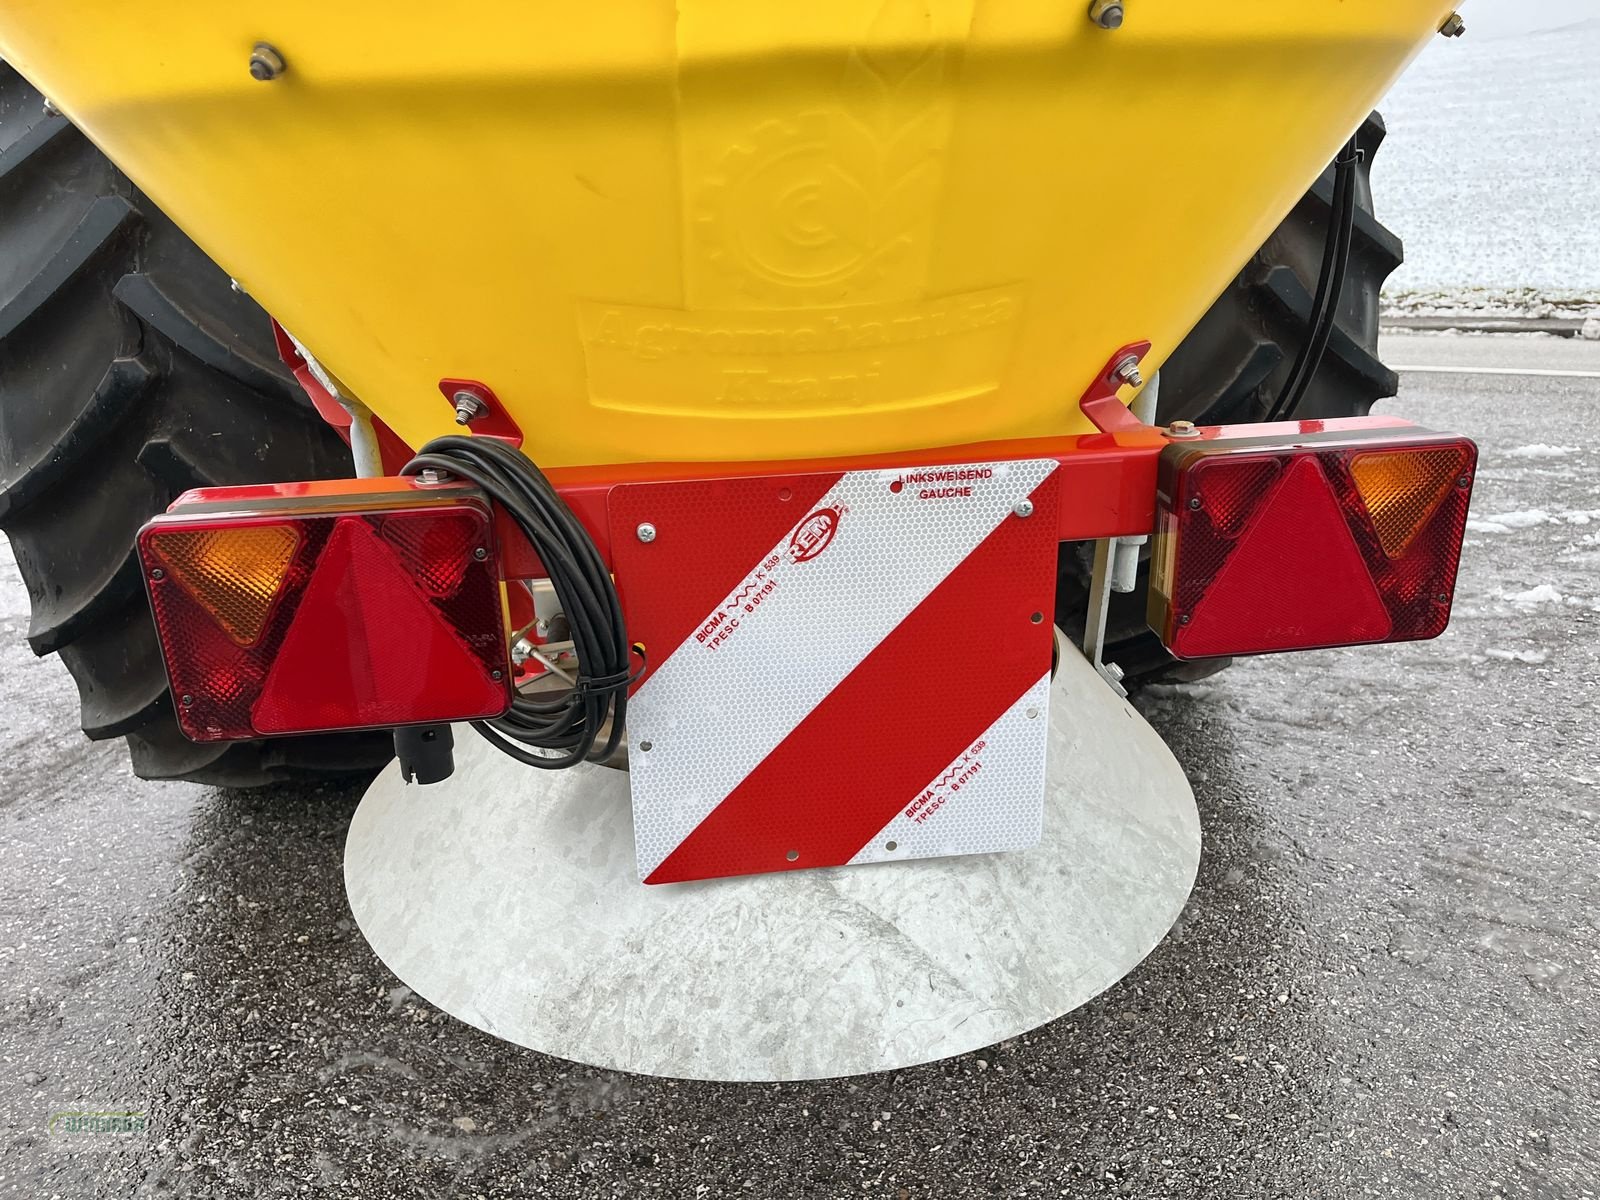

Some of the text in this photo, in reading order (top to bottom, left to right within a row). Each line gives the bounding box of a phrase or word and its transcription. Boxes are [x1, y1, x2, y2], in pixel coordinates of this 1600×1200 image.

[919, 487, 972, 499] GAUCHE
[696, 554, 780, 643] BICMA K 539
[707, 618, 739, 650] TPESC
[744, 603, 754, 613] B
[752, 579, 777, 605] 07191
[905, 740, 986, 818] BICMA K 539
[914, 796, 945, 825] TPESC
[951, 783, 960, 791] B
[958, 761, 982, 784] 07191
